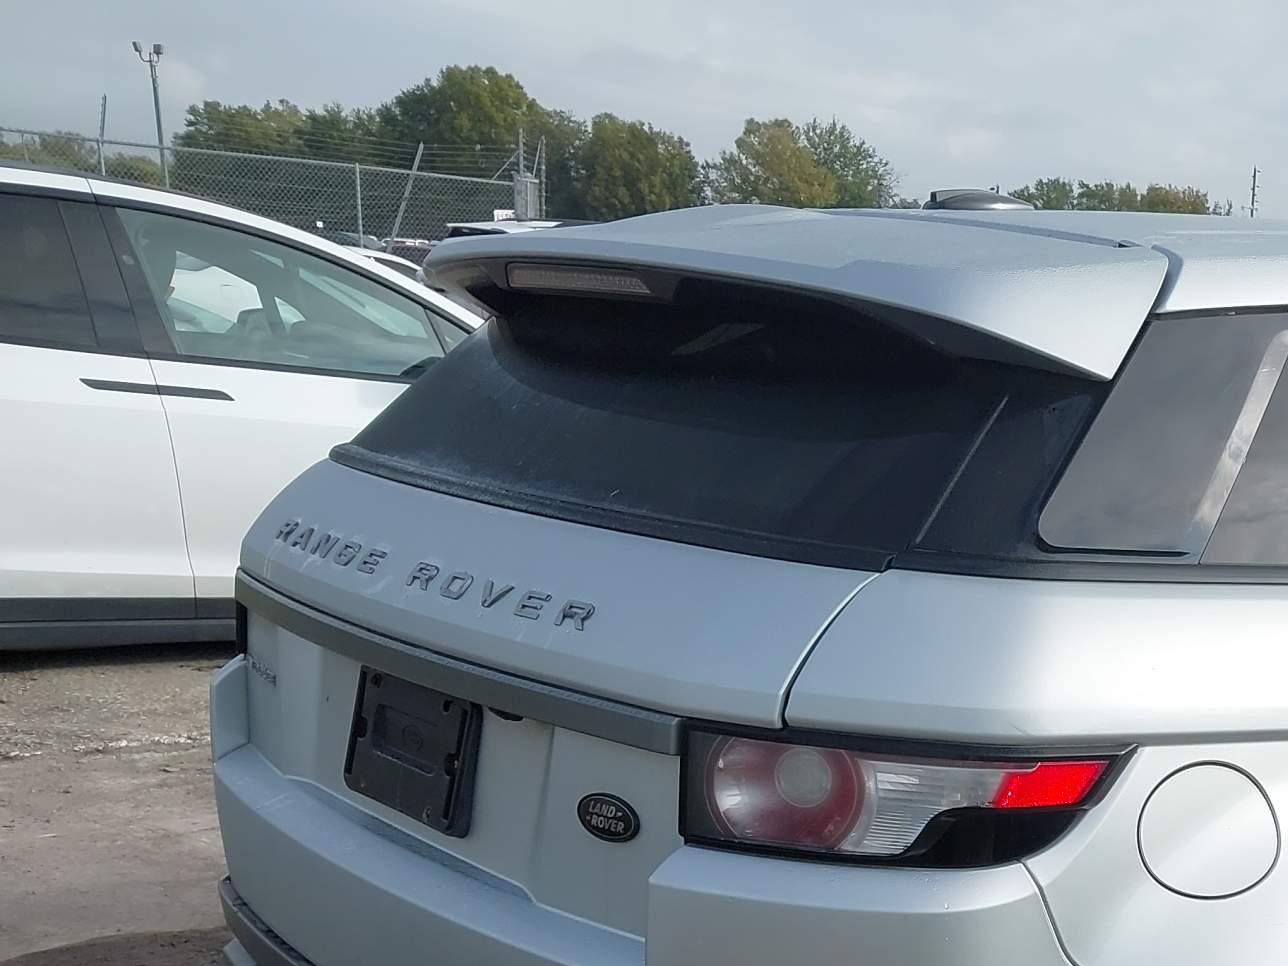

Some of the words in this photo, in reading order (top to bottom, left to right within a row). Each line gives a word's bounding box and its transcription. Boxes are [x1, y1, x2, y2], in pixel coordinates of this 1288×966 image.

[275, 520, 388, 575] RANGE
[406, 561, 596, 631] ROVER
[589, 801, 616, 818] LAND
[591, 814, 625, 833] ROVER
